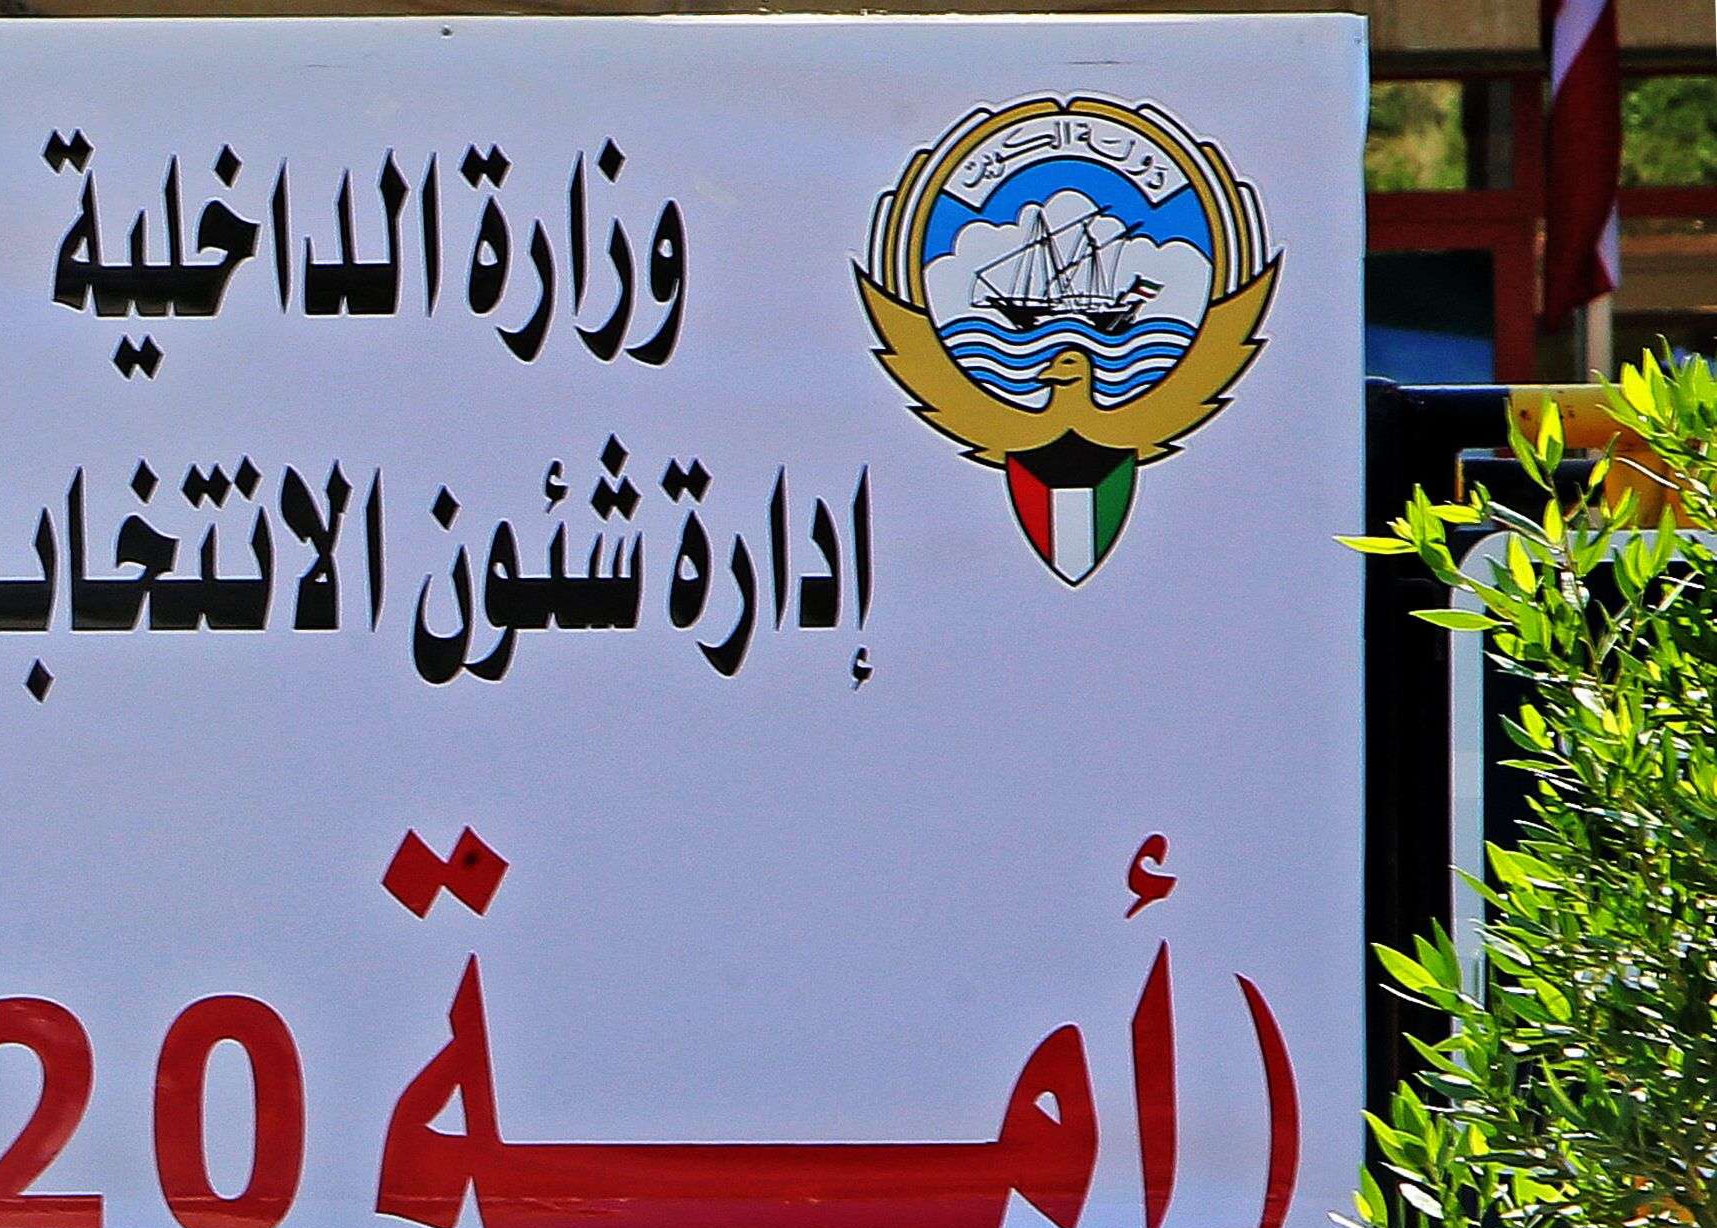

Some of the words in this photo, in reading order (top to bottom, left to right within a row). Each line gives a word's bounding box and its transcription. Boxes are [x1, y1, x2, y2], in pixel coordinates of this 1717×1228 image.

[42, 128, 441, 380] الداخلية
[460, 137, 687, 367] وزارة
[962, 119, 1071, 189] الكويت
[411, 432, 643, 686] شئون
[661, 457, 874, 692] إدارة
